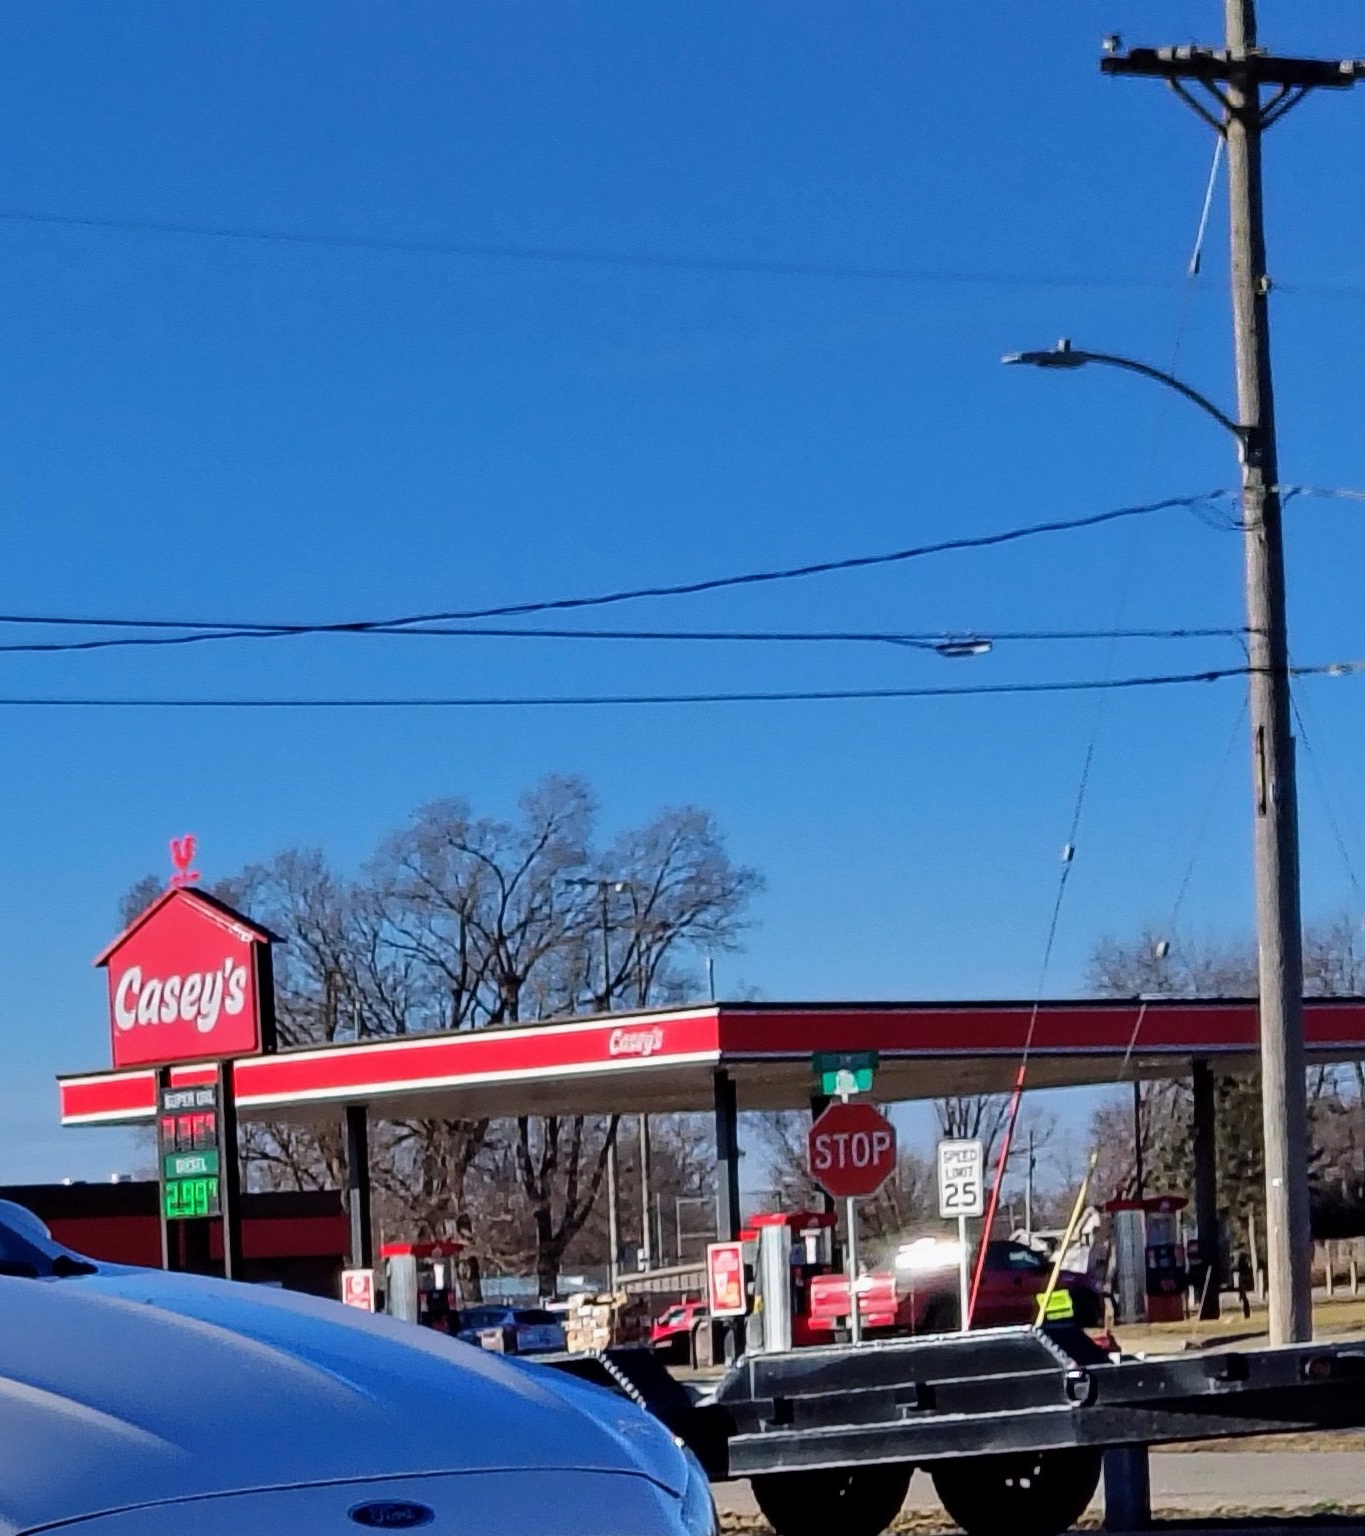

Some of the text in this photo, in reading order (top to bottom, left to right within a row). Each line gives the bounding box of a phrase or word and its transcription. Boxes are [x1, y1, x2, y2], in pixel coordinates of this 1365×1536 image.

[114, 956, 247, 1033] Casey's
[609, 1026, 664, 1056] Casey's
[815, 1130, 890, 1169] STOP
[943, 1150, 977, 1164] SPEED
[945, 1165, 973, 1180] LIMIT
[944, 1182, 977, 1207] 25
